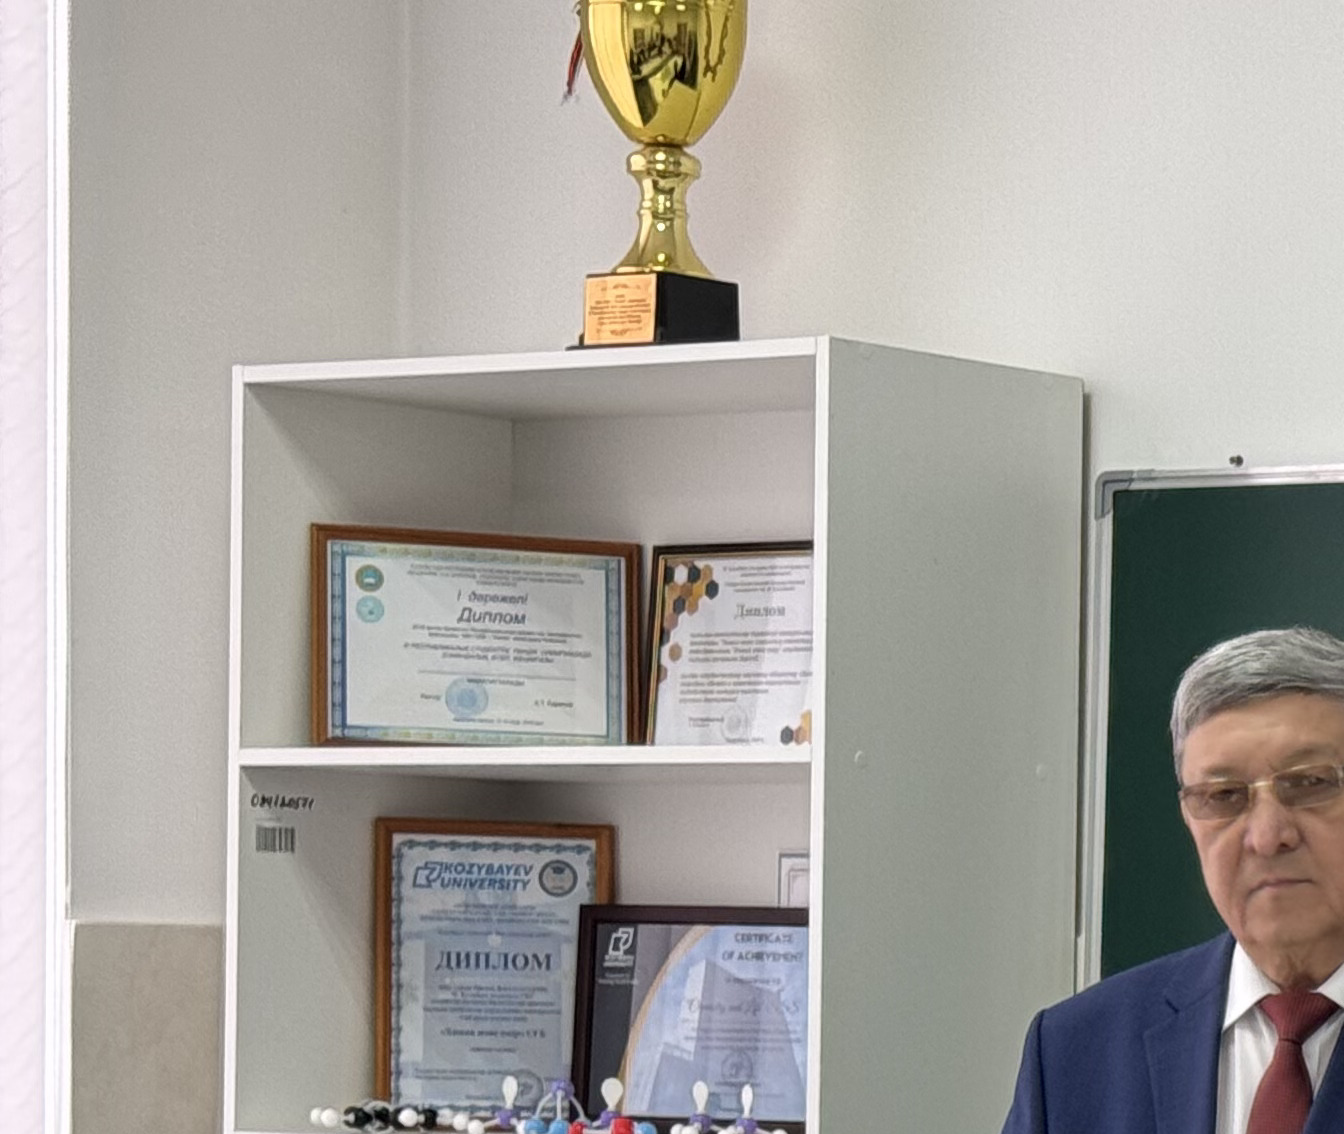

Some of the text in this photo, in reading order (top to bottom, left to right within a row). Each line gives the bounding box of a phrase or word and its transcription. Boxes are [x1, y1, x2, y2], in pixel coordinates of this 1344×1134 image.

[456, 606, 527, 625] Диплом
[734, 602, 786, 619] Диплом
[441, 861, 534, 877] KOZYBAYEV
[440, 877, 532, 892] UNIVERSITY
[734, 932, 793, 944] CERTIFICATE
[435, 950, 553, 972] ДИПЛОМ
[721, 950, 735, 962] OF
